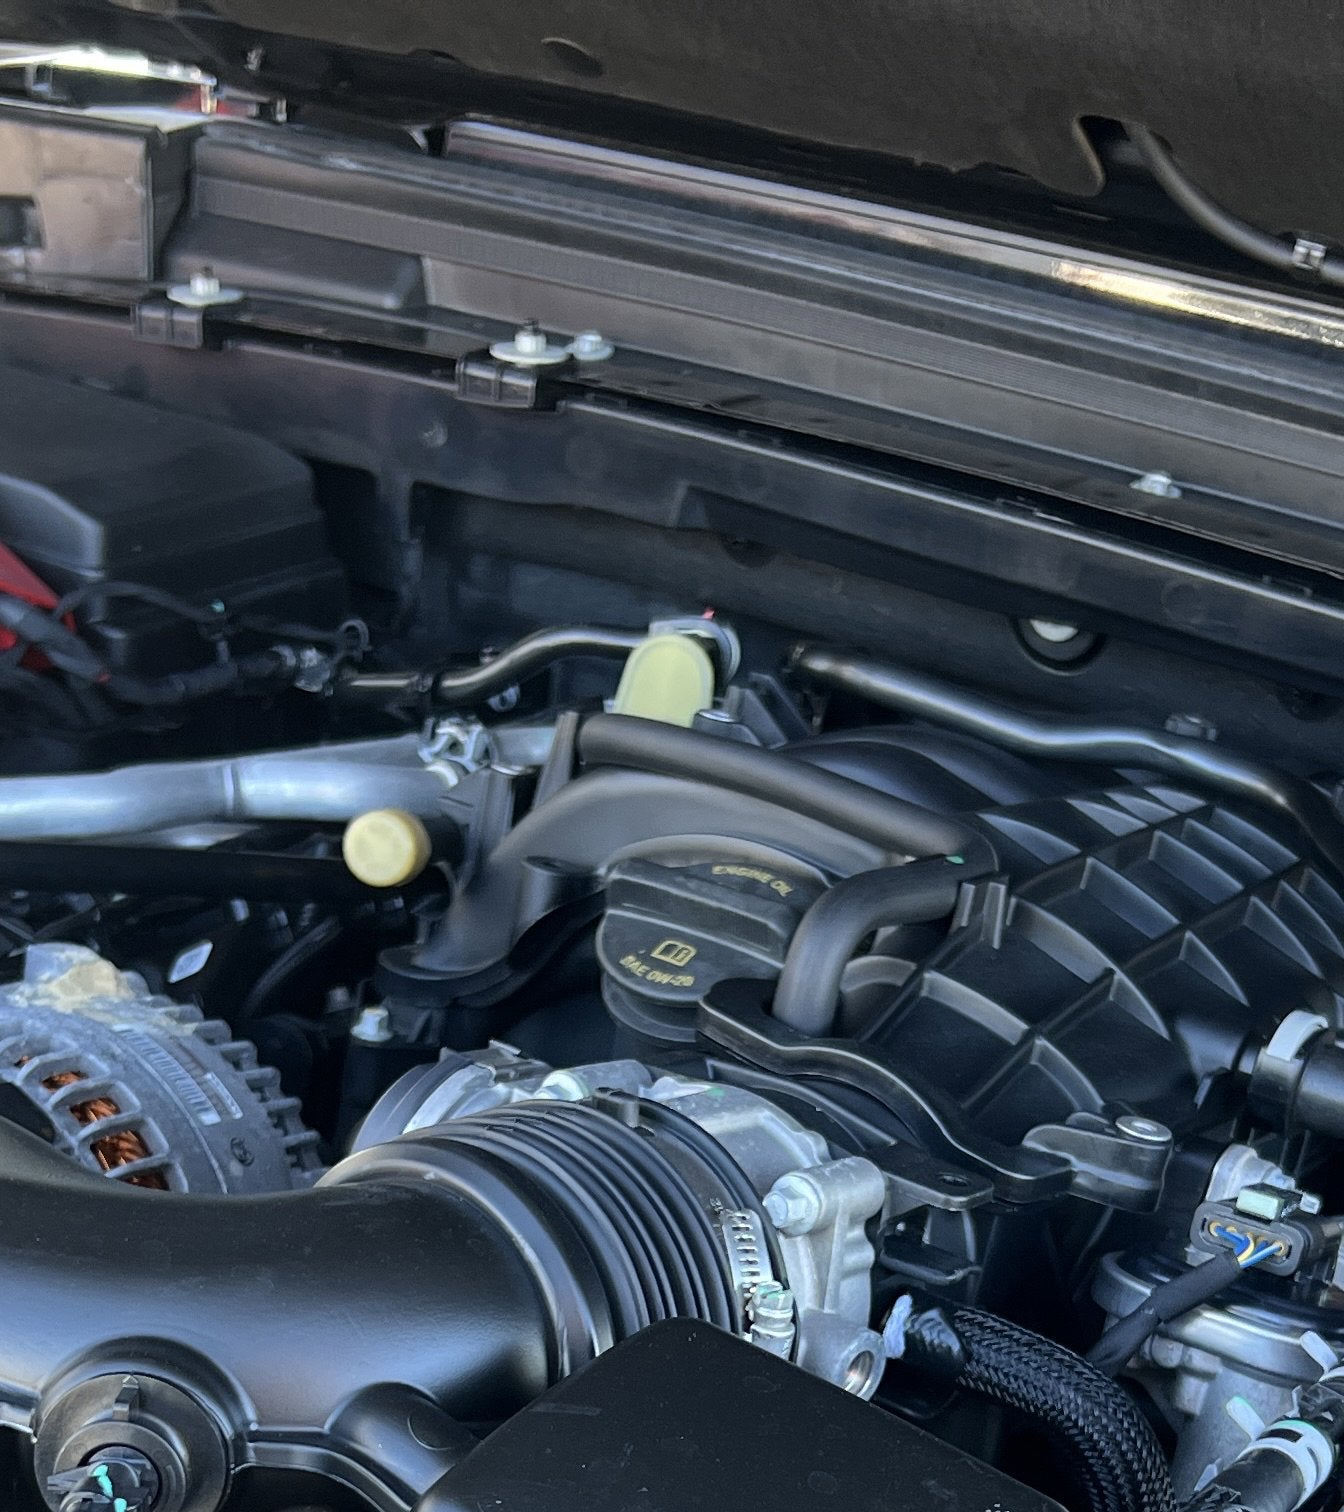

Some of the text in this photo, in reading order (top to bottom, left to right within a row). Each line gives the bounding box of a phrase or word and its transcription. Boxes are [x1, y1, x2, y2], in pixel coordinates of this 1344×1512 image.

[711, 865, 795, 897] ENGINE OIL
[619, 955, 695, 987] SAE 0W-20
